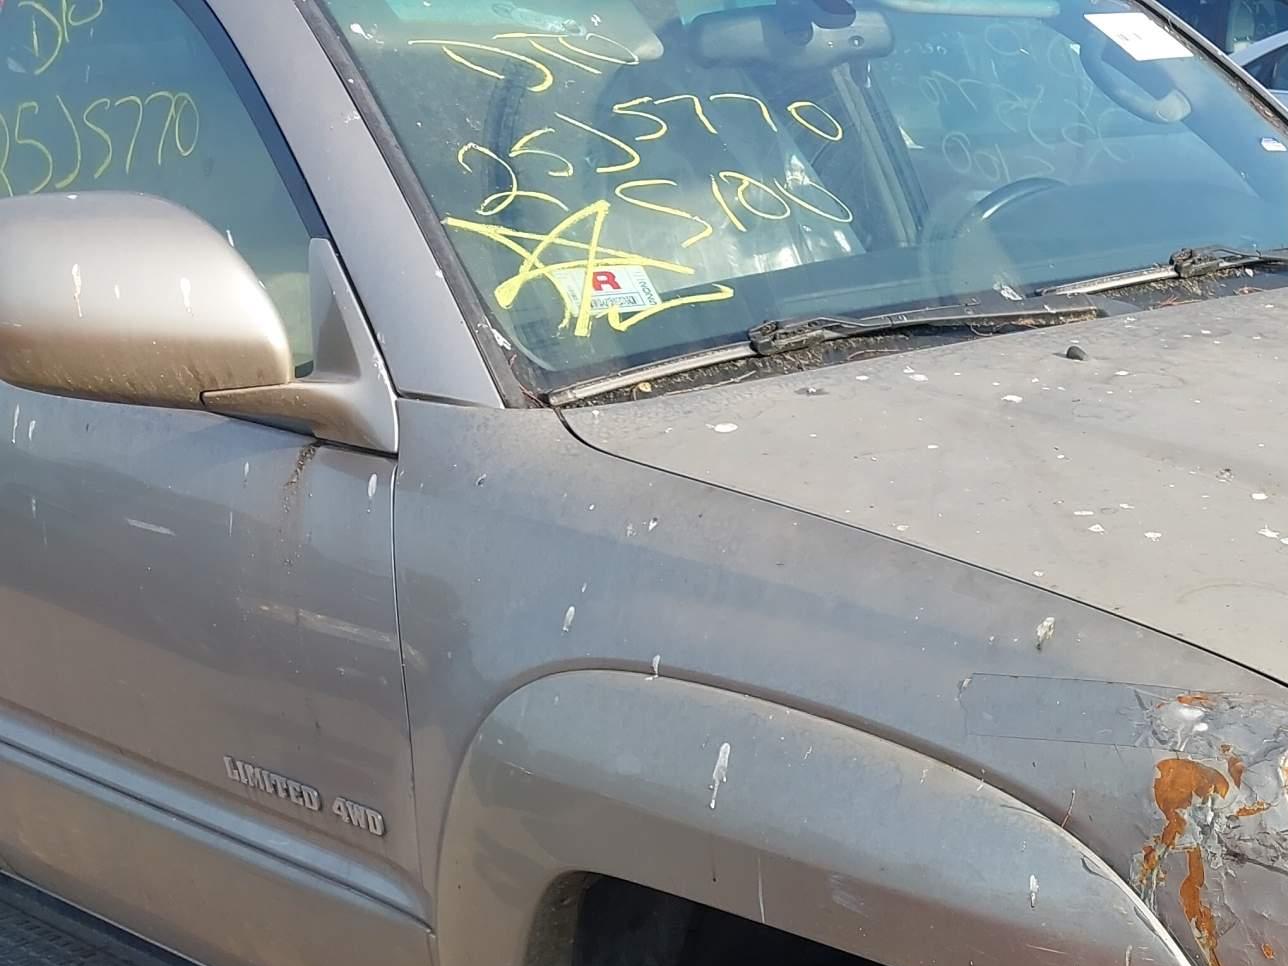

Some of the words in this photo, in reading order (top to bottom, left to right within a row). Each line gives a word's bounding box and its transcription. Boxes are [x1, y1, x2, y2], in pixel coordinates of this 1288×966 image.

[592, 271, 622, 291] R
[223, 755, 321, 811] LIMITED
[332, 796, 386, 836] 4WD
